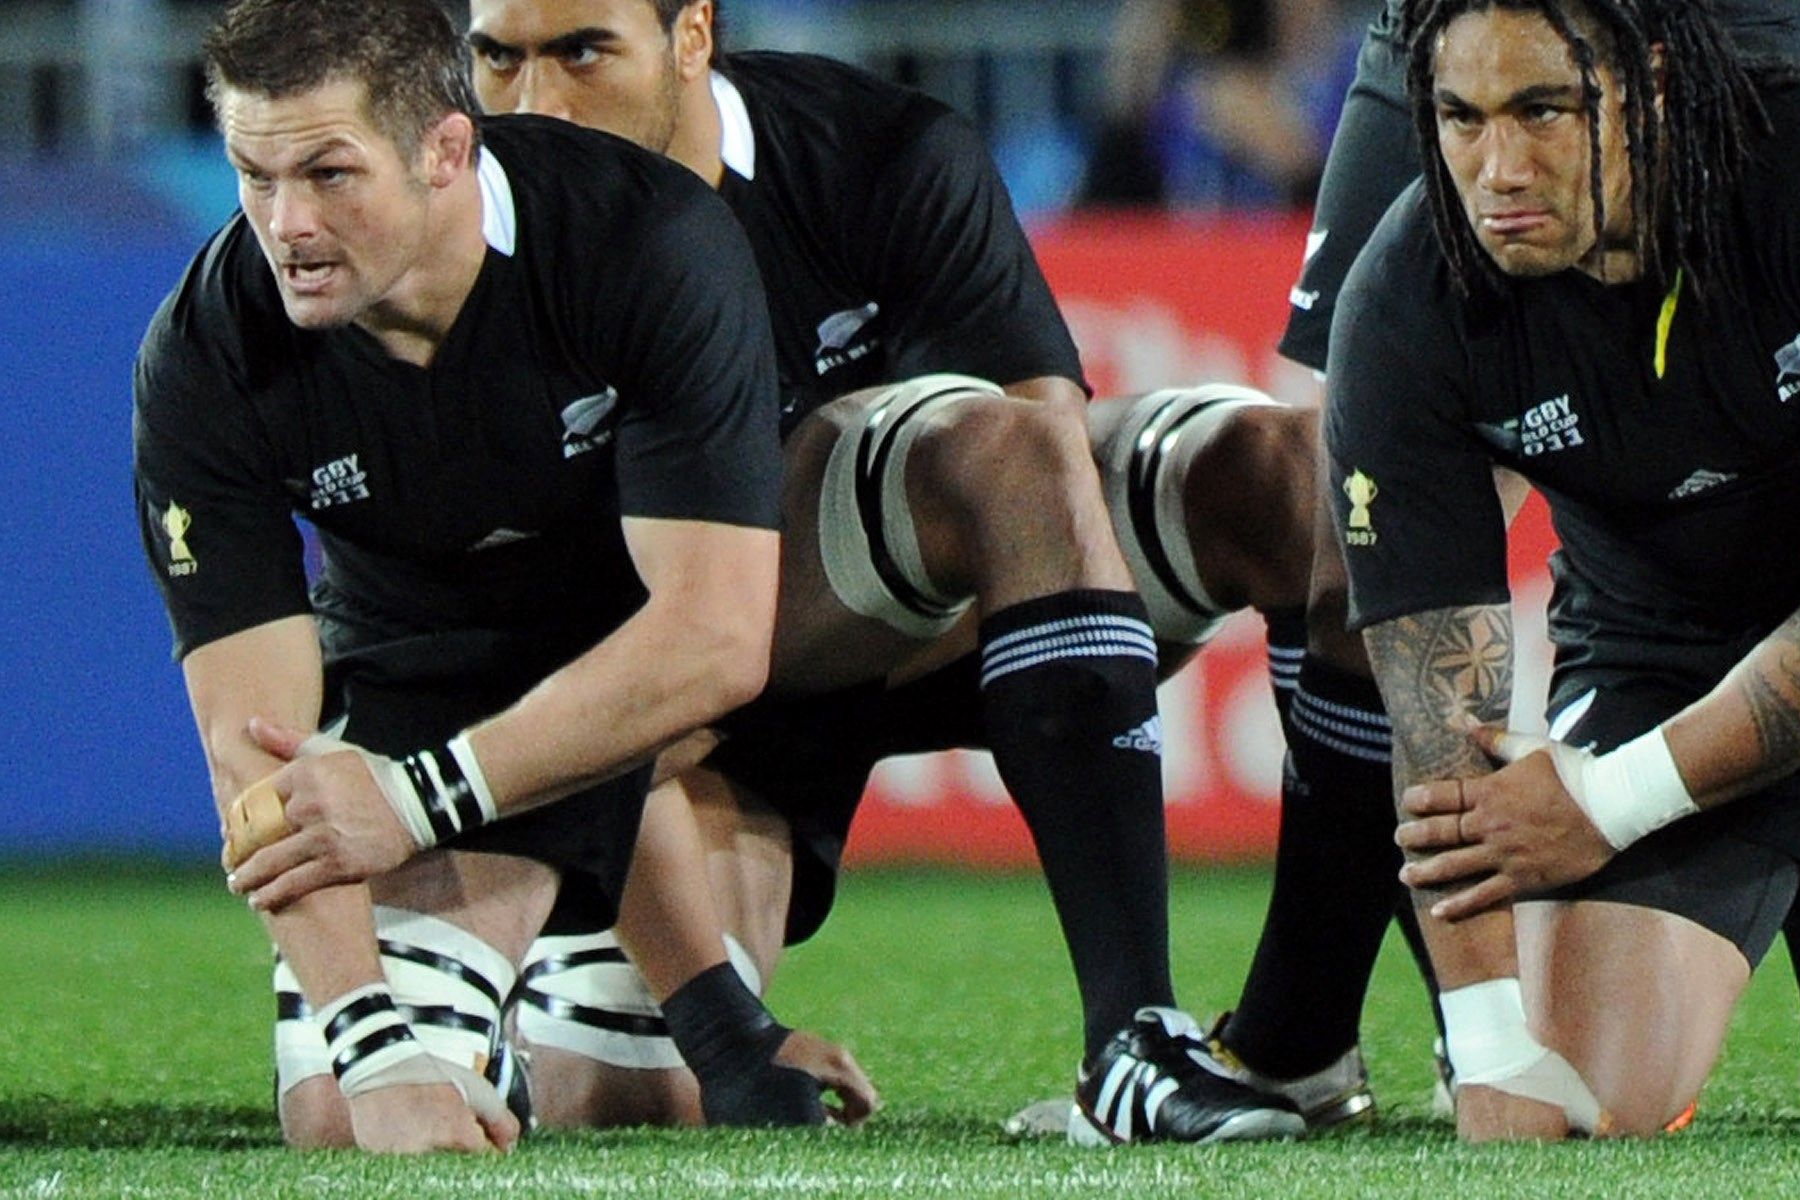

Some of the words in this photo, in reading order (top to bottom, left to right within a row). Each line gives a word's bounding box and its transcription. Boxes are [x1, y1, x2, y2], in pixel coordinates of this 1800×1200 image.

[1524, 393, 1570, 429] GBY
[1524, 427, 1584, 456] 011
[312, 453, 359, 486] GBY
[1346, 531, 1377, 546] 1987
